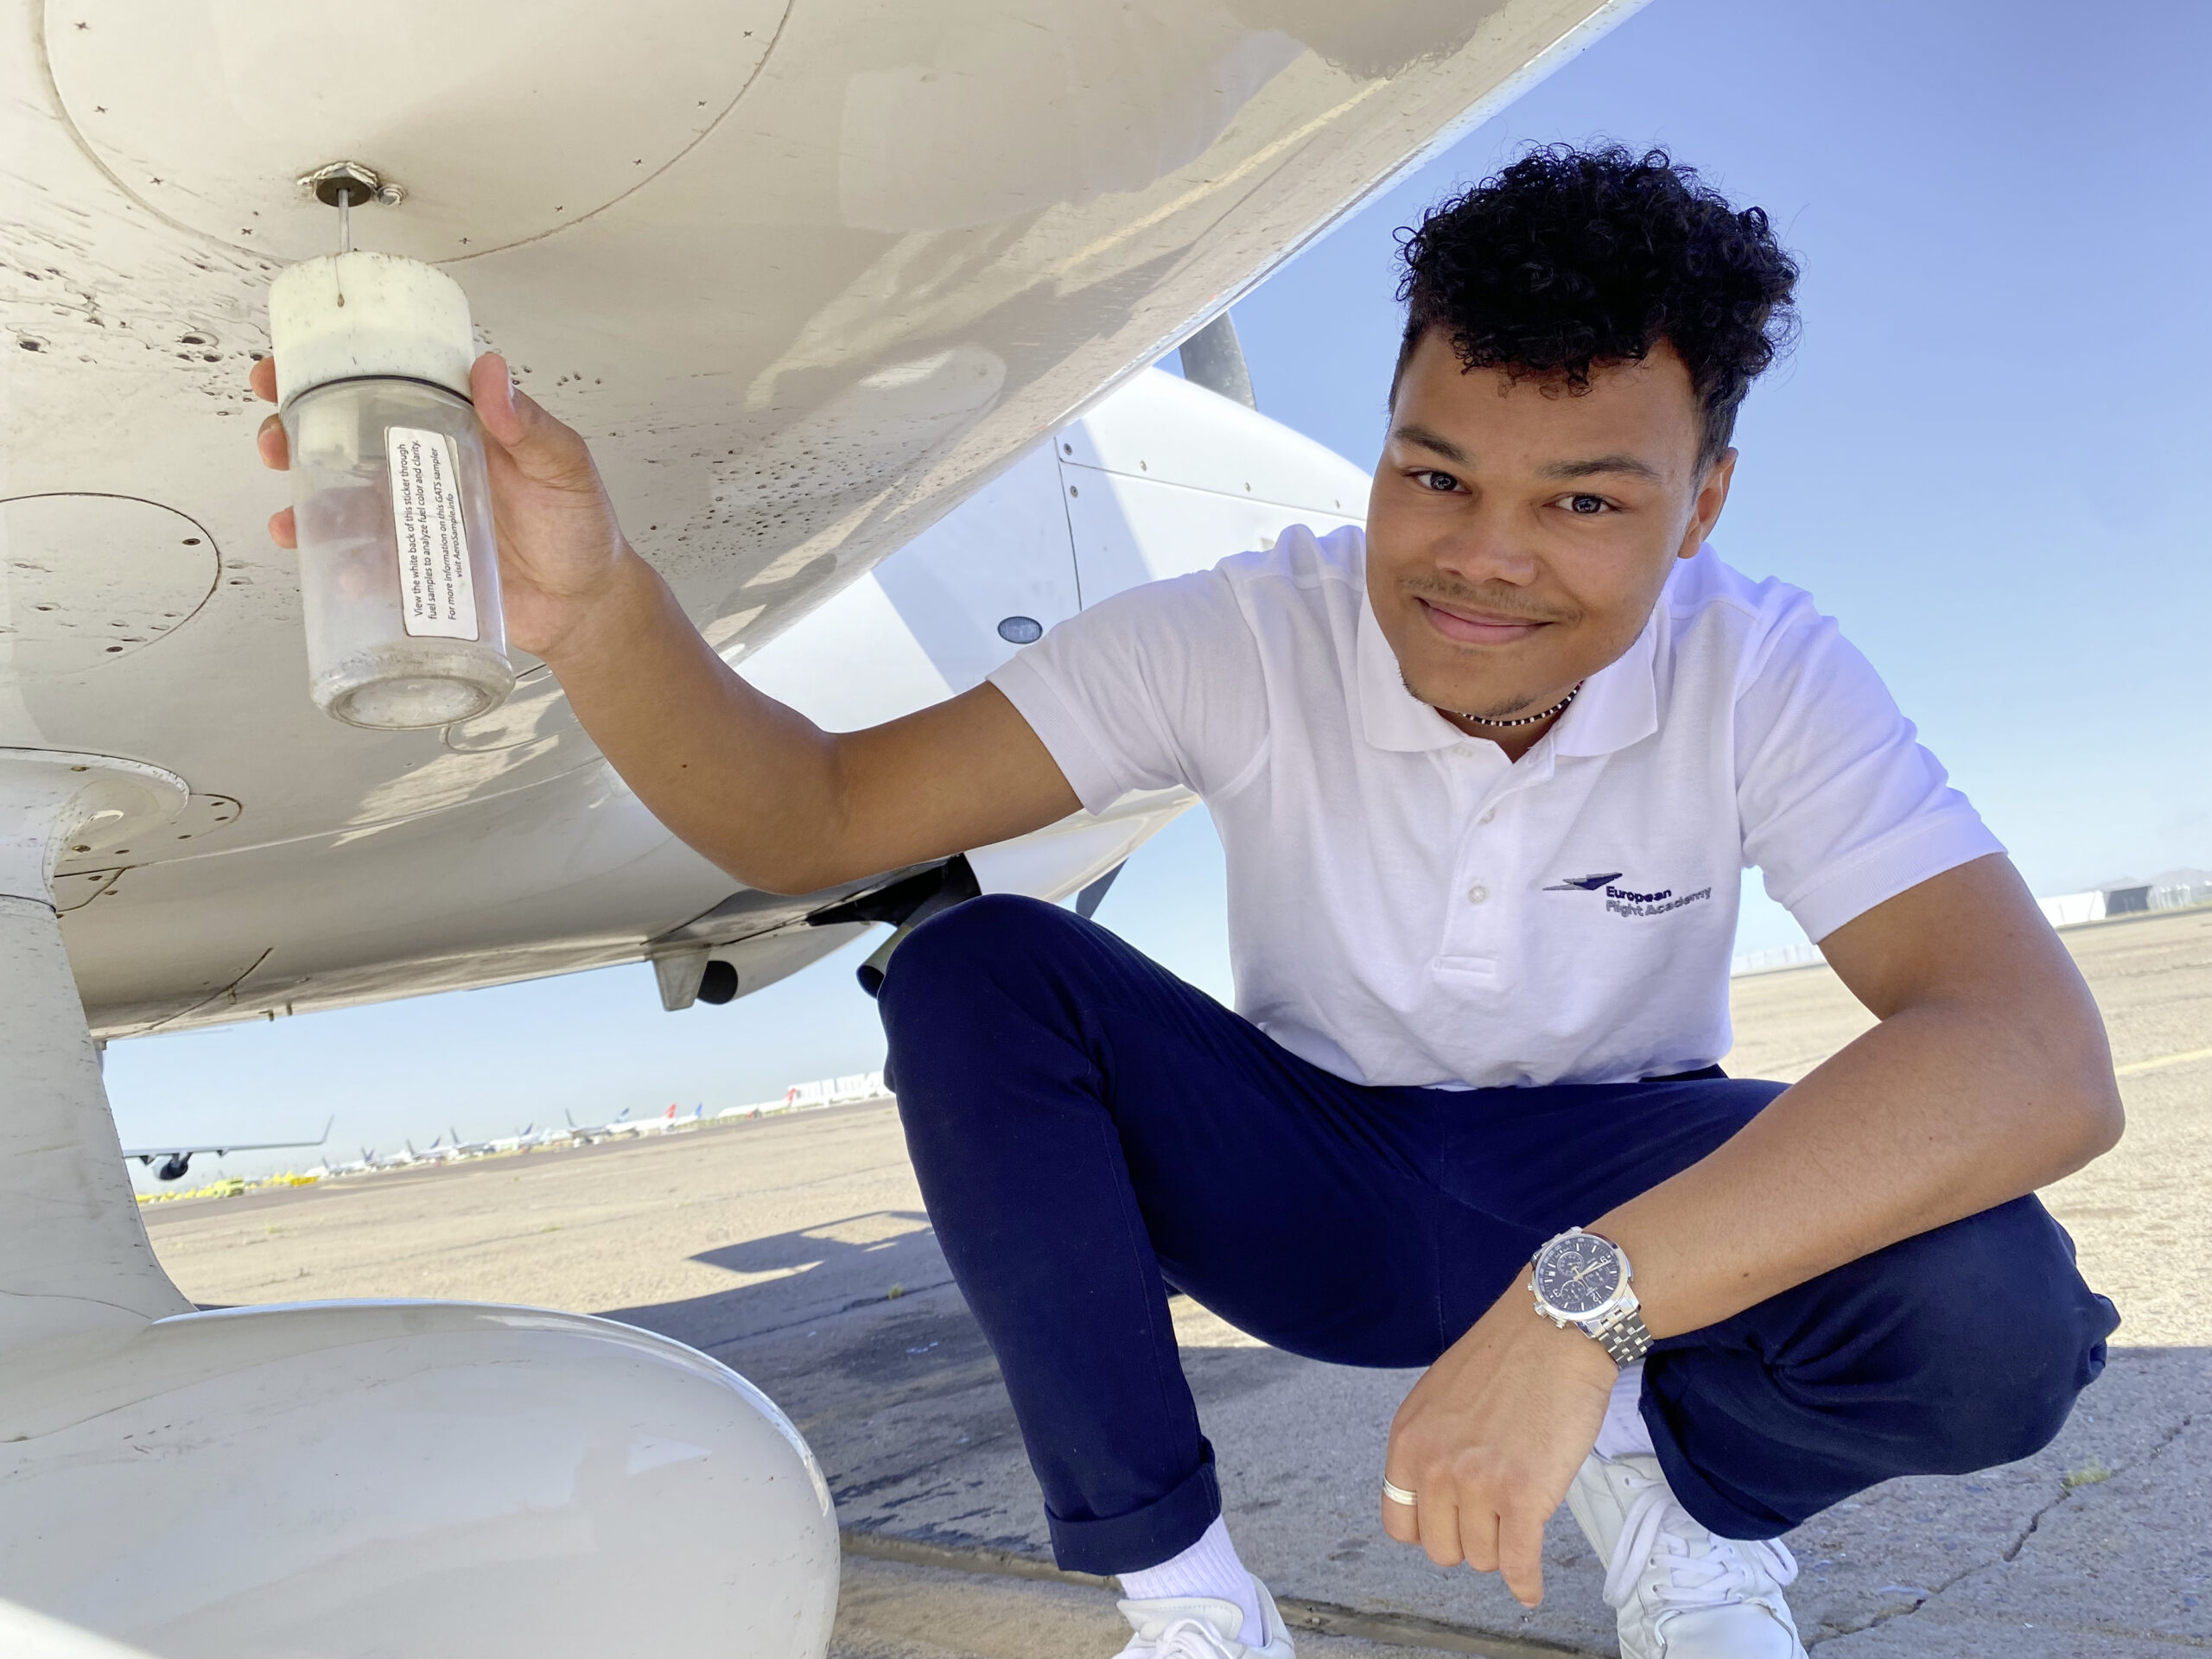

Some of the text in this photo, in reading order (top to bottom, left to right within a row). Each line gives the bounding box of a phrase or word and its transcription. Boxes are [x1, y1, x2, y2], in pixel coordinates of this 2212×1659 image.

[411, 441, 421, 466] clarity.
[430, 448, 441, 480] sampler
[412, 468, 423, 484] and
[415, 486, 425, 505] color
[433, 482, 442, 503] GATS
[416, 507, 427, 522] fuel
[397, 444, 423, 617] View the white back of this sticker through
[440, 521, 446, 531] on
[446, 493, 463, 577] visit AeroSample.info
[420, 524, 430, 556] analyze
[442, 534, 452, 581] information
[424, 568, 435, 601] samples
[427, 603, 437, 619] fuel
[448, 607, 456, 620] For
[1606, 886, 1672, 904] European
[1606, 887, 1712, 917] Flight Academy
[1552, 1288, 1561, 1298] 3
